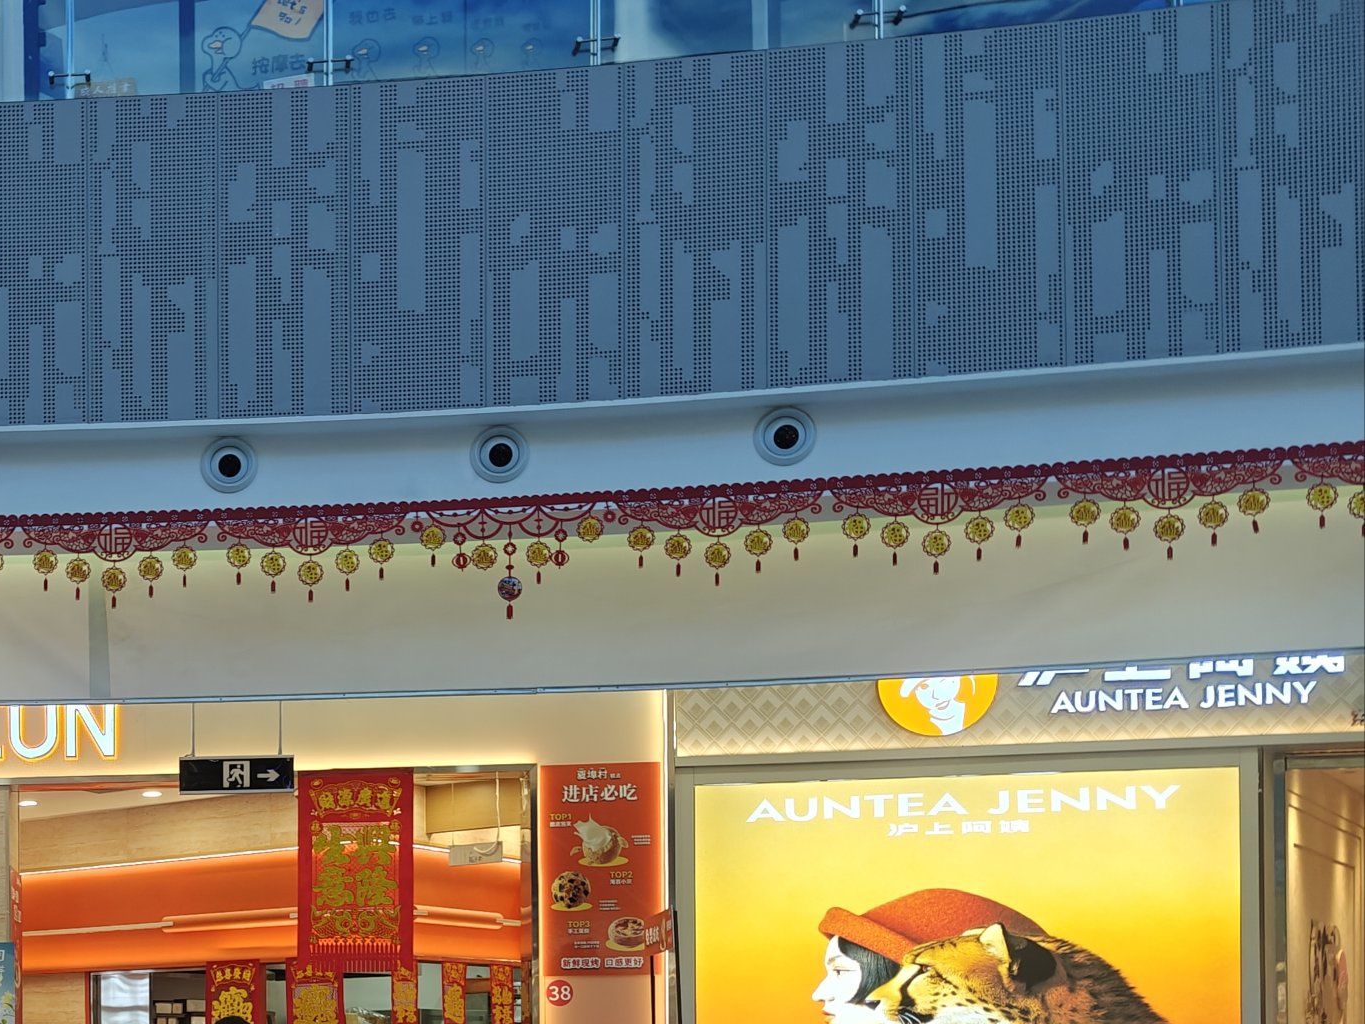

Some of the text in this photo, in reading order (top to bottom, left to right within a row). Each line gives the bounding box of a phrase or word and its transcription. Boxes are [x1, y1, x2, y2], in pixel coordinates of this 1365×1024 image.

[1050, 680, 1317, 714] AUNTEA JENNY
[561, 783, 638, 803] 进店必吃
[745, 784, 1181, 824] AUNTEA JENNY
[886, 818, 1030, 838] 沪上阿姨
[610, 871, 633, 879] TOP2
[548, 985, 572, 1001] 38
